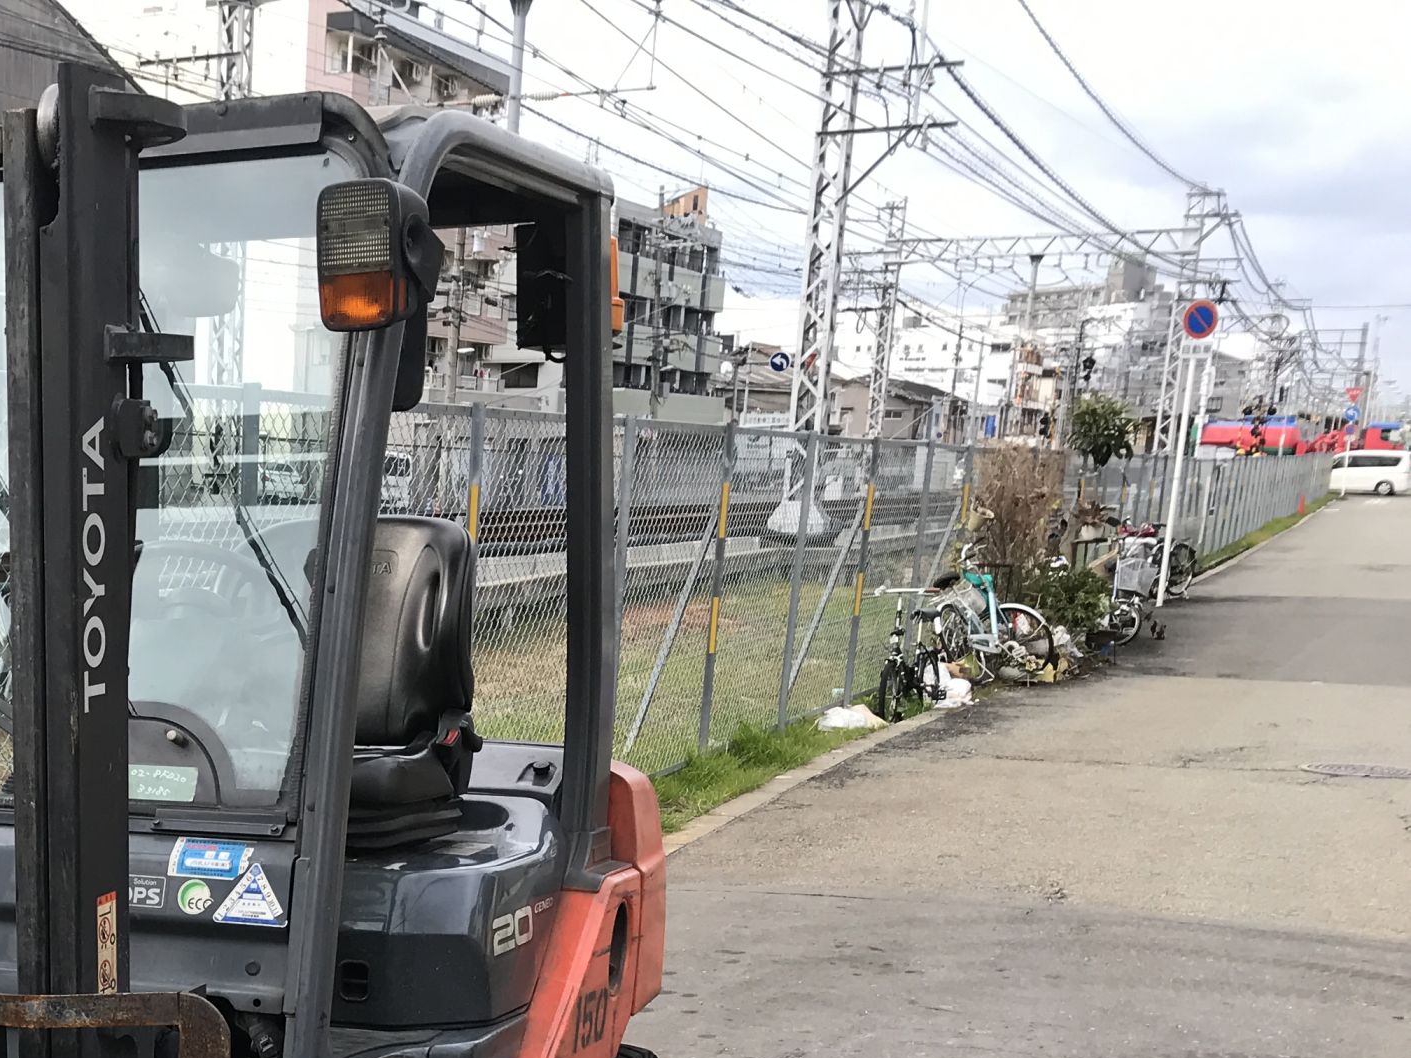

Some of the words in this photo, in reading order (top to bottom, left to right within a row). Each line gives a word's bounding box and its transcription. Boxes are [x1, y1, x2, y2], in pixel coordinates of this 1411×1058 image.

[82, 416, 107, 713] TOYOTA
[129, 886, 161, 905] PS
[133, 877, 157, 886] Solution
[492, 905, 534, 957] 20
[573, 987, 608, 1054] 150
